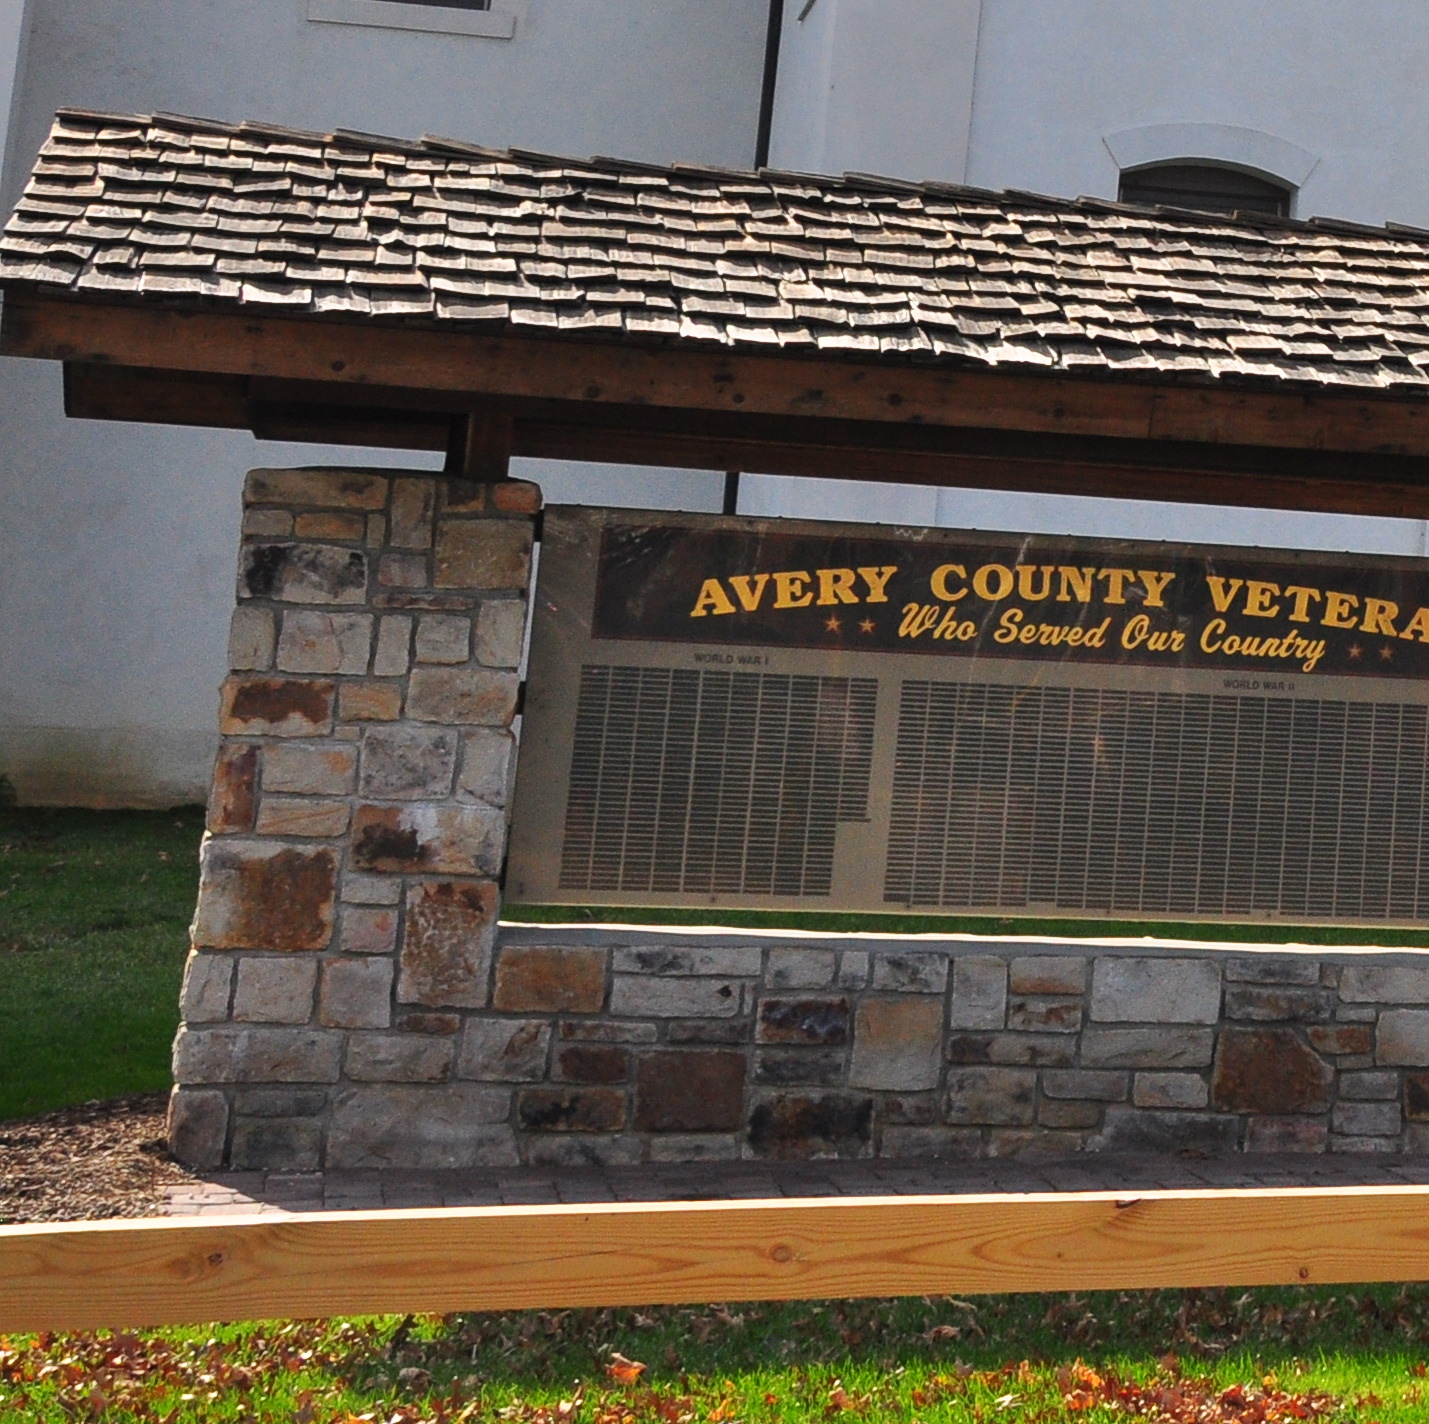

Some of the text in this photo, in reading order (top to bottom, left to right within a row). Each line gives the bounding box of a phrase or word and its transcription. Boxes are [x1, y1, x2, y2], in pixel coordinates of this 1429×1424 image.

[689, 564, 898, 617] AVERY
[930, 563, 1176, 608] COUNTY
[898, 602, 1326, 673] Who Served Our Country
[694, 653, 734, 665] WORLD
[1223, 679, 1260, 690] WORLD
[1262, 681, 1286, 691] WAR
